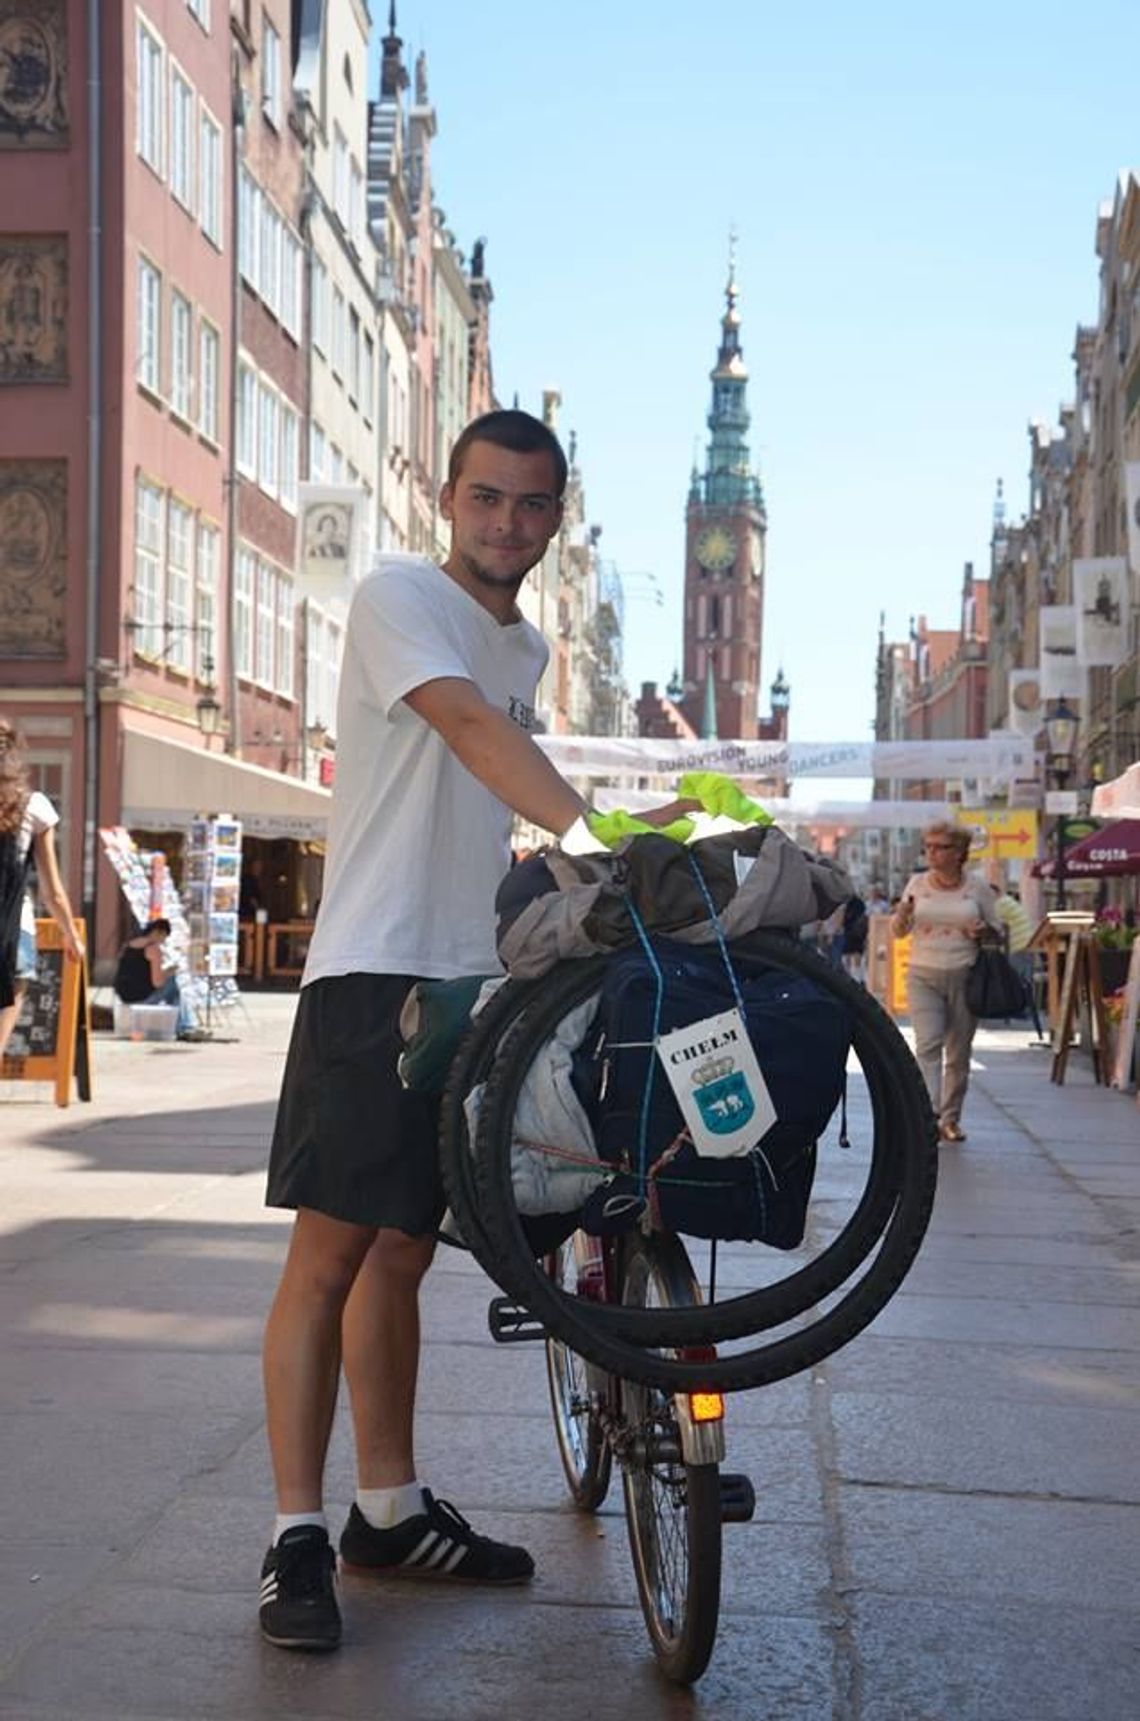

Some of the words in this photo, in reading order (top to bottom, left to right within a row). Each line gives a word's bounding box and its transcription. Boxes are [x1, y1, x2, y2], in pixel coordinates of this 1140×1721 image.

[738, 752, 789, 772] YOUNG
[789, 750, 858, 773] DANCERS
[1089, 848, 1128, 861] COSTA
